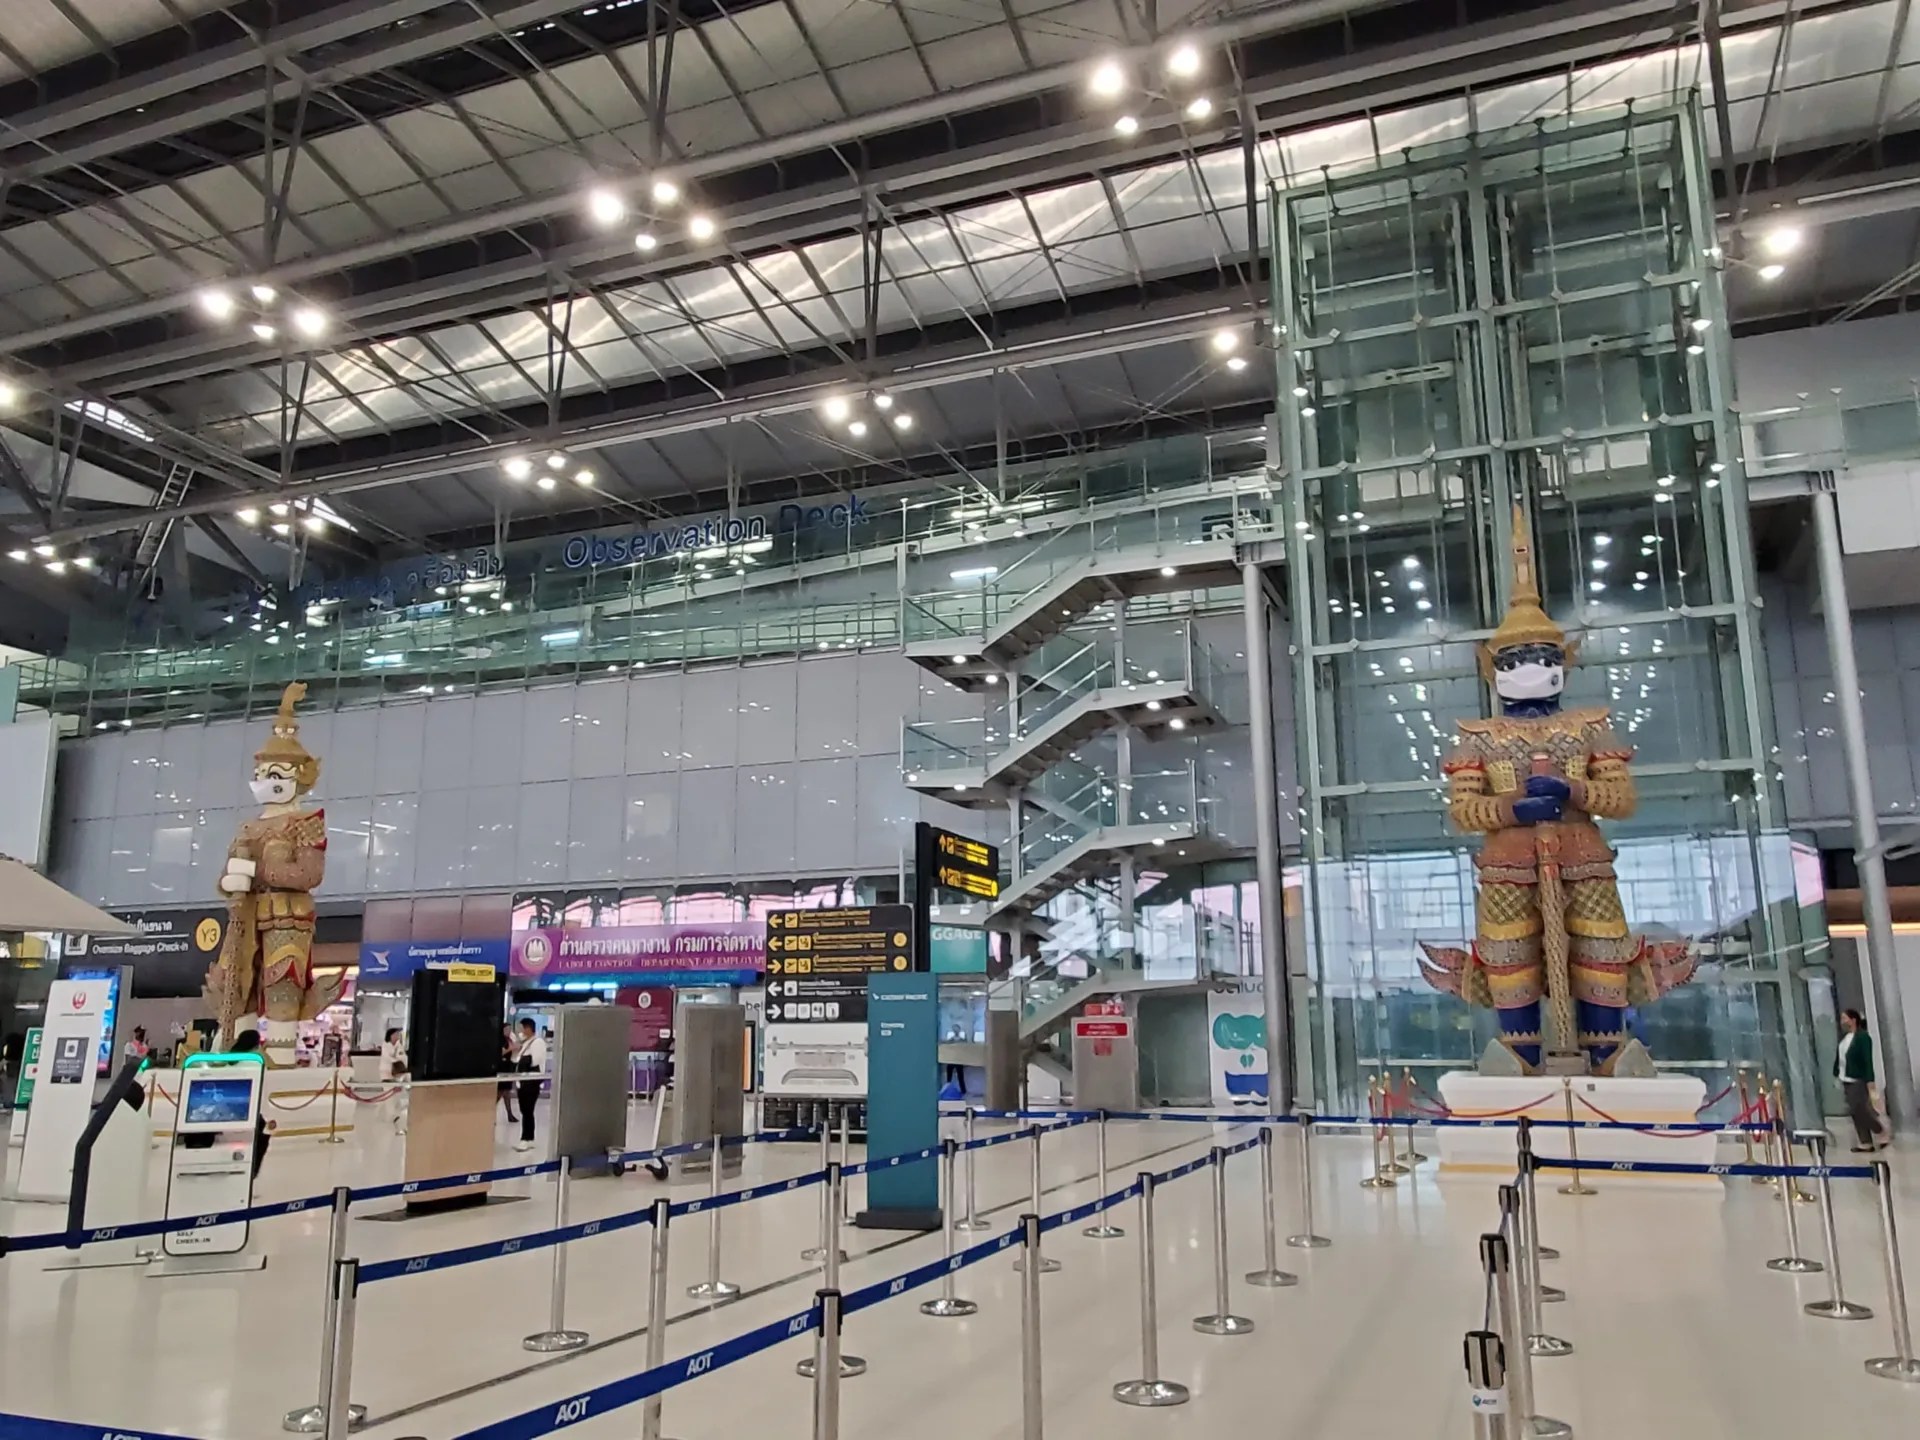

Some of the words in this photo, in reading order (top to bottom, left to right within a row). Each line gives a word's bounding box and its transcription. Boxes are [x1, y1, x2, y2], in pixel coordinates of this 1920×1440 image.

[563, 514, 766, 568] Observation
[779, 494, 870, 533] Deck
[201, 929, 217, 941] Y3
[124, 942, 155, 955] Baggage
[156, 942, 188, 952] Check-in
[559, 960, 592, 968] LABOUR
[594, 959, 632, 968] CONTROL
[641, 957, 699, 967] DEPARTMENT
[702, 956, 714, 965] OF
[1611, 1162, 1634, 1170] AOT
[1707, 1165, 1730, 1174] AOT
[1808, 1167, 1832, 1176] AOT
[466, 1173, 482, 1184] AOT
[402, 1182, 419, 1192] AOT
[286, 1200, 307, 1211] AOT
[195, 1215, 219, 1226] AOT
[91, 1228, 118, 1241] AOT
[583, 1223, 601, 1235] AOT
[501, 1240, 522, 1252] AOT
[405, 1257, 431, 1272] AOT
[889, 1277, 907, 1295] AOT
[787, 1314, 810, 1334] AOT
[686, 1353, 714, 1376] AOT
[554, 1396, 591, 1425] AOT
